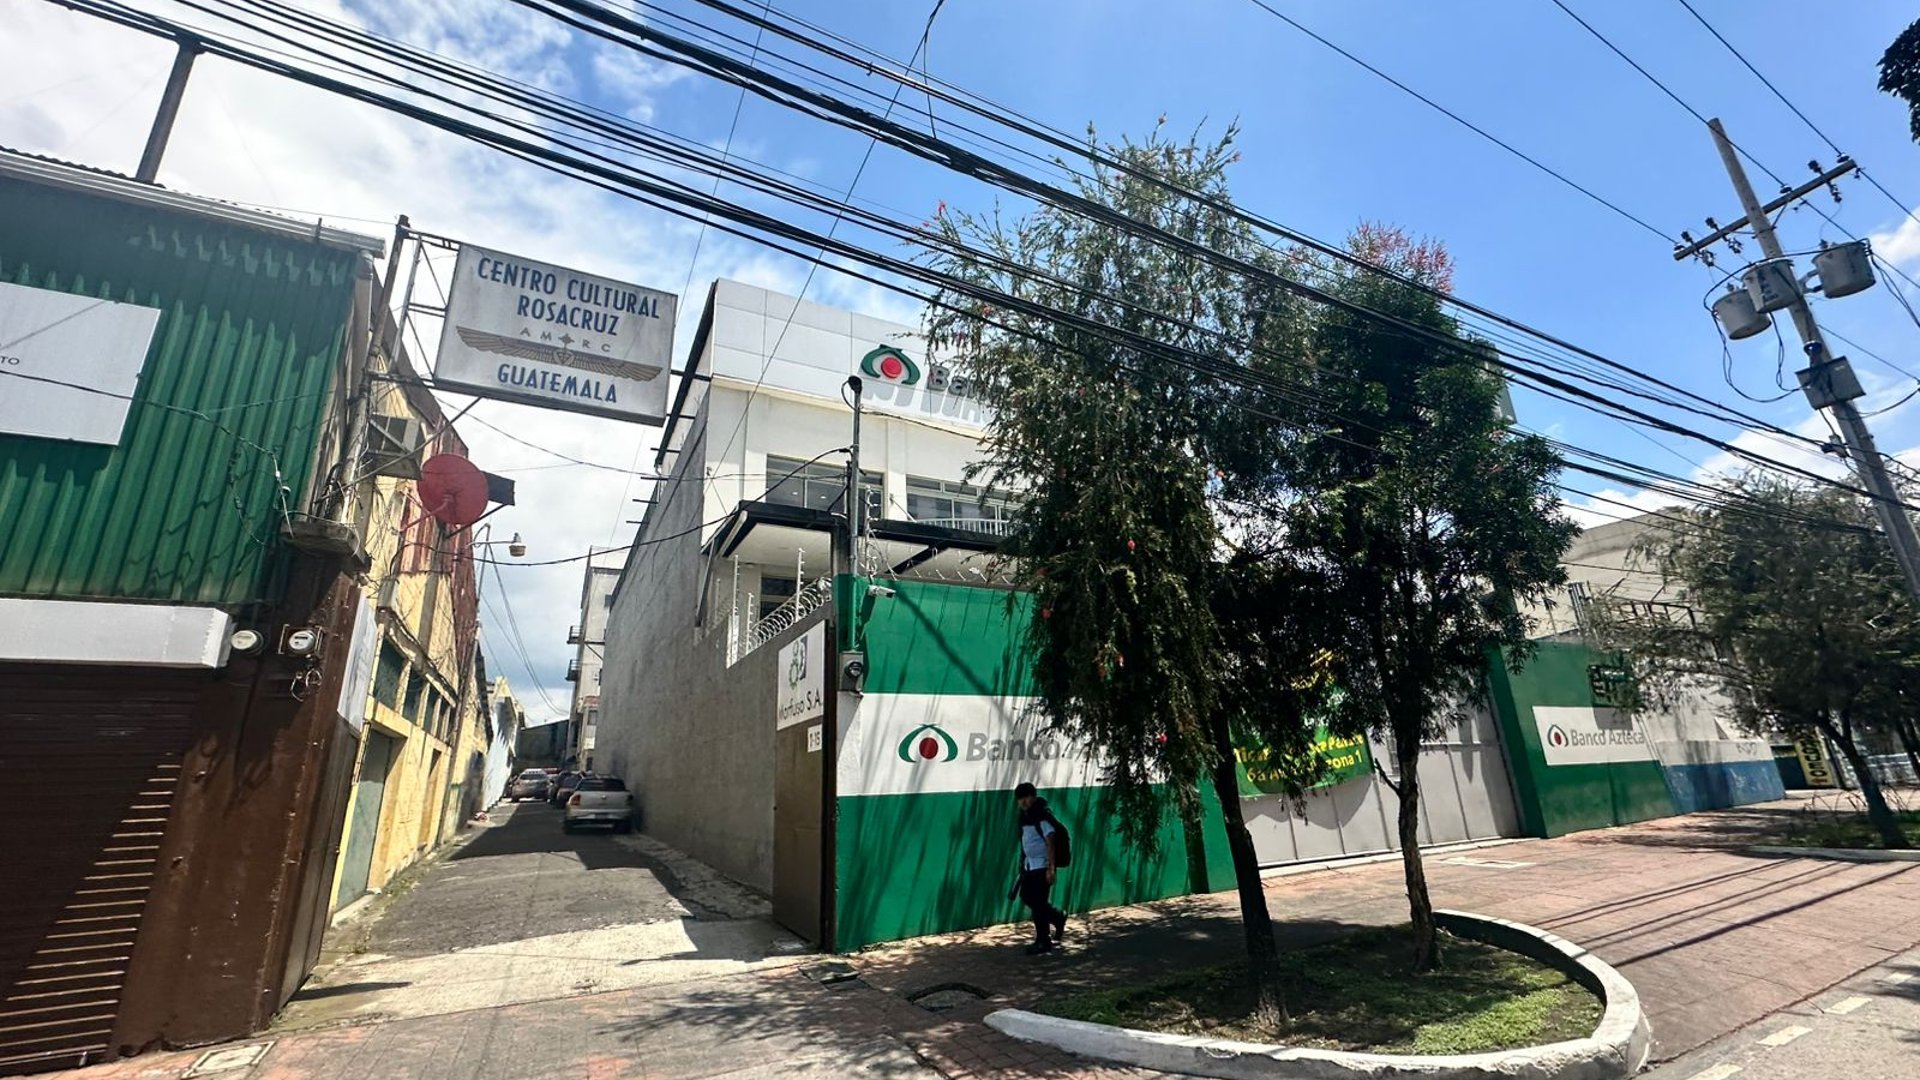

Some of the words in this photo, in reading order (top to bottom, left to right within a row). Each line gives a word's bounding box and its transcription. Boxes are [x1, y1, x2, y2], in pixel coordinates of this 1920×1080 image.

[478, 257, 556, 295] CENTRO
[567, 279, 660, 319] CULTURAL
[517, 295, 619, 336] ROSACRUZ
[497, 363, 618, 404] GUATEMALA
[966, 732, 1061, 762] Banco
[1571, 729, 1606, 746] Banco
[1608, 728, 1646, 745] Azteca
